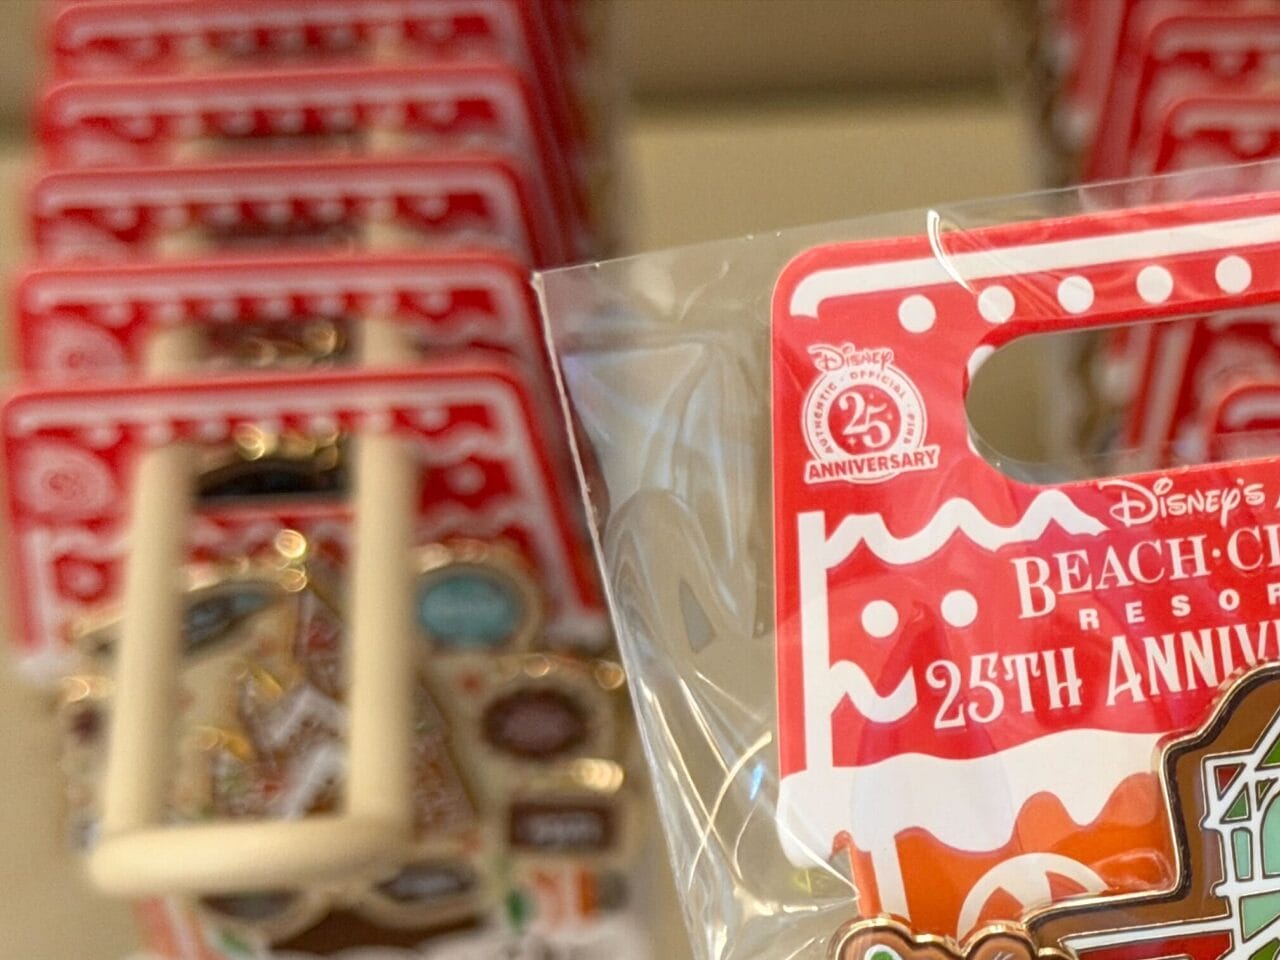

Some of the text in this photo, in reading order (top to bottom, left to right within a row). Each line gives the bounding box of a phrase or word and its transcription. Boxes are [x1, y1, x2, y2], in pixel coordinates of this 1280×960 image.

[838, 392, 892, 448] 25
[808, 450, 937, 480] ANNIVERSARY
[926, 646, 1083, 730] 25TH
